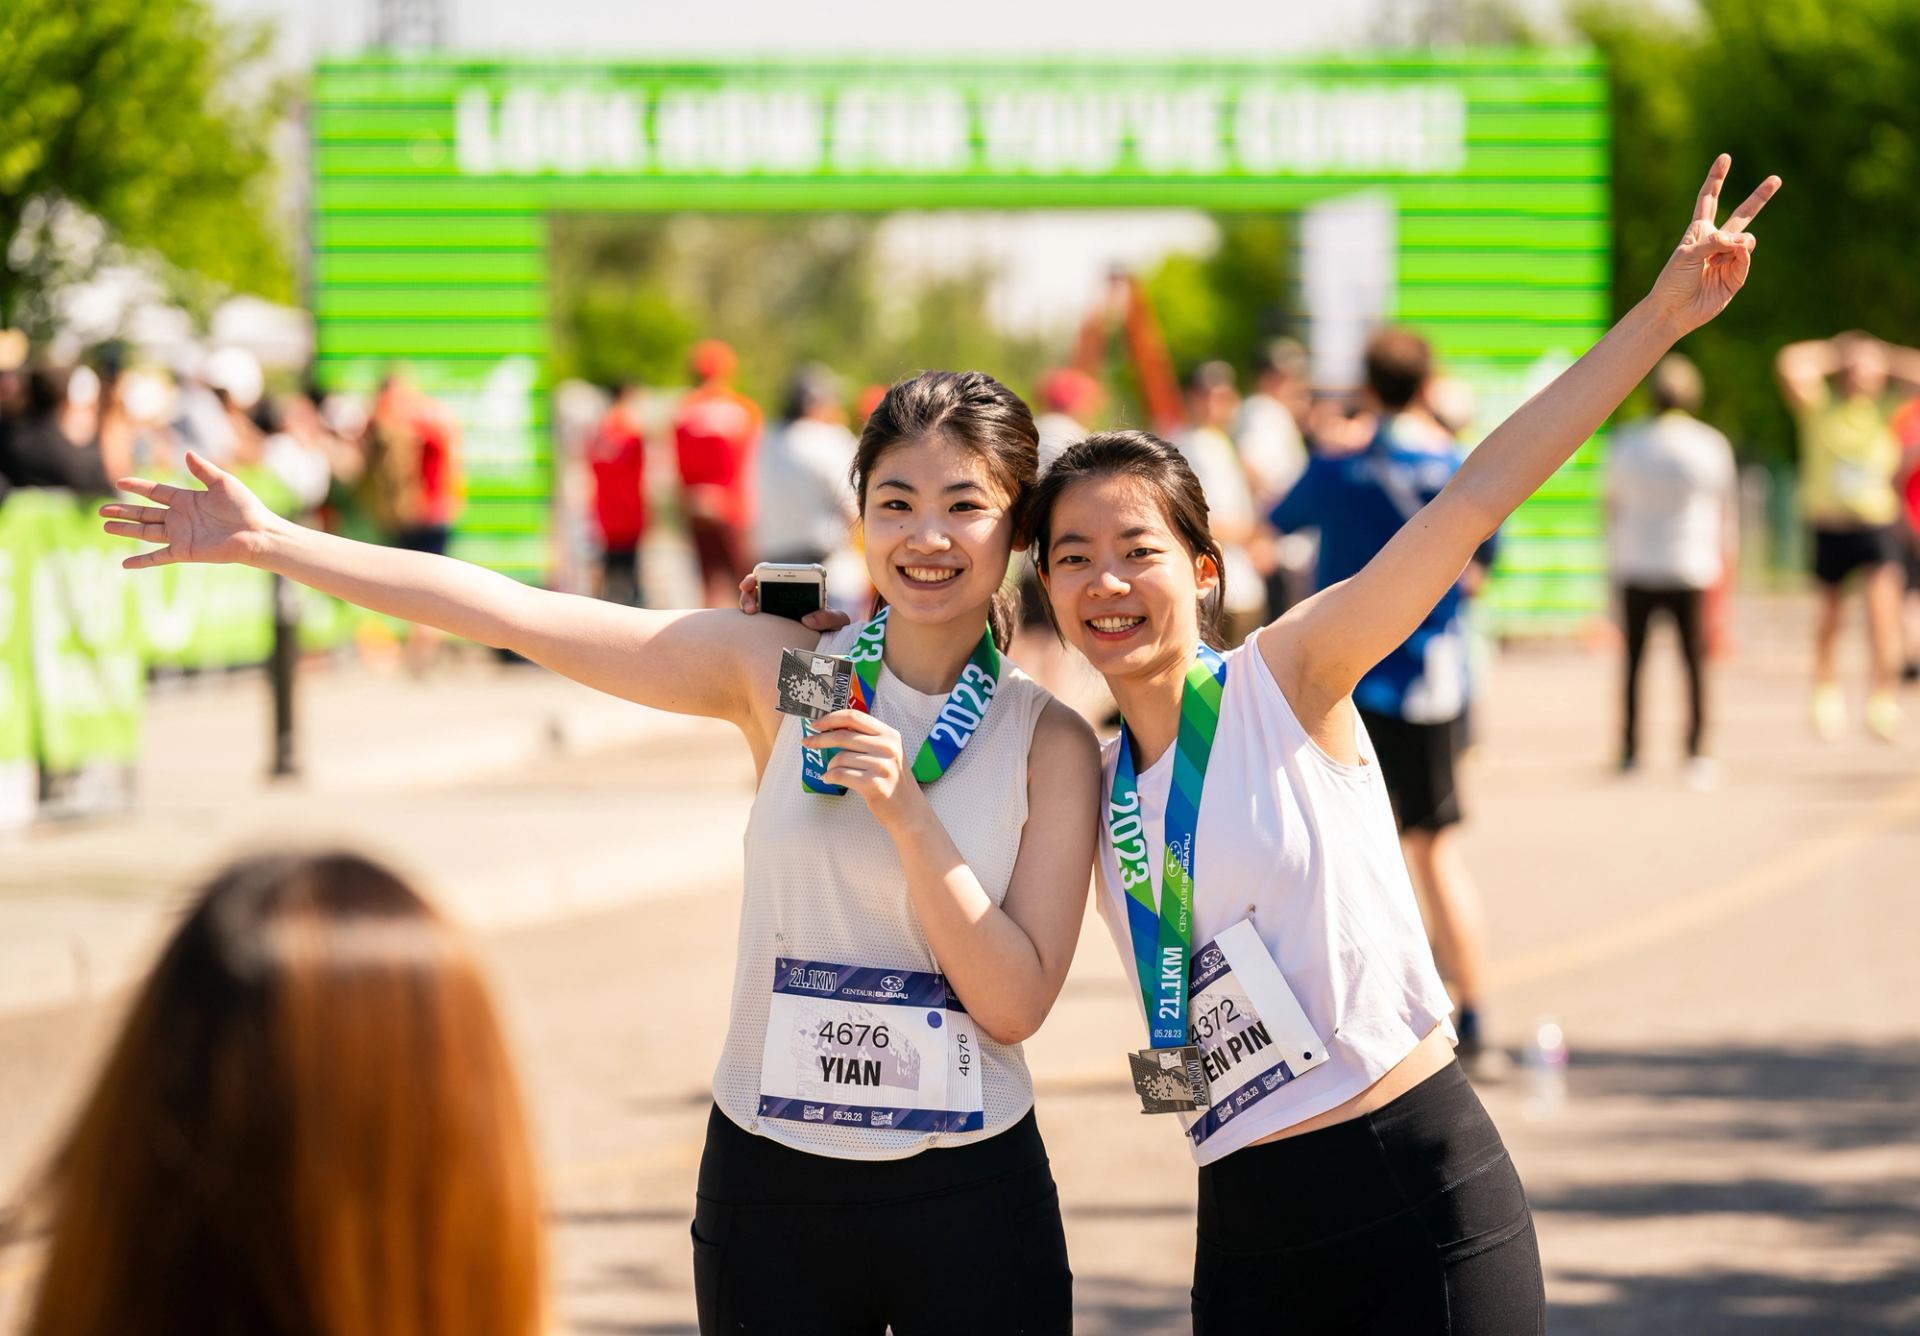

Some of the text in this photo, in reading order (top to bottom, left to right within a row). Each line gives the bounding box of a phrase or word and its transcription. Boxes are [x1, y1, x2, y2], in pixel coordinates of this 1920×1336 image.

[849, 604, 891, 663] 023
[930, 664, 997, 749] 2023
[1109, 791, 1150, 889] 2023
[1181, 833, 1191, 884] SUBARU
[789, 968, 837, 992] 21.1KM
[875, 991, 908, 1000] SUBARU
[1159, 947, 1183, 1019] 21.1KM
[819, 1021, 890, 1048] 4676
[1154, 1029, 1182, 1038] 05.28.23
[1191, 999, 1240, 1044] 4372
[820, 1056, 882, 1087] YIAN
[957, 1033, 971, 1077] 4676
[1202, 1046, 1231, 1084] EN
[1226, 1020, 1273, 1064] PIN
[832, 1110, 863, 1122] 05.28.23
